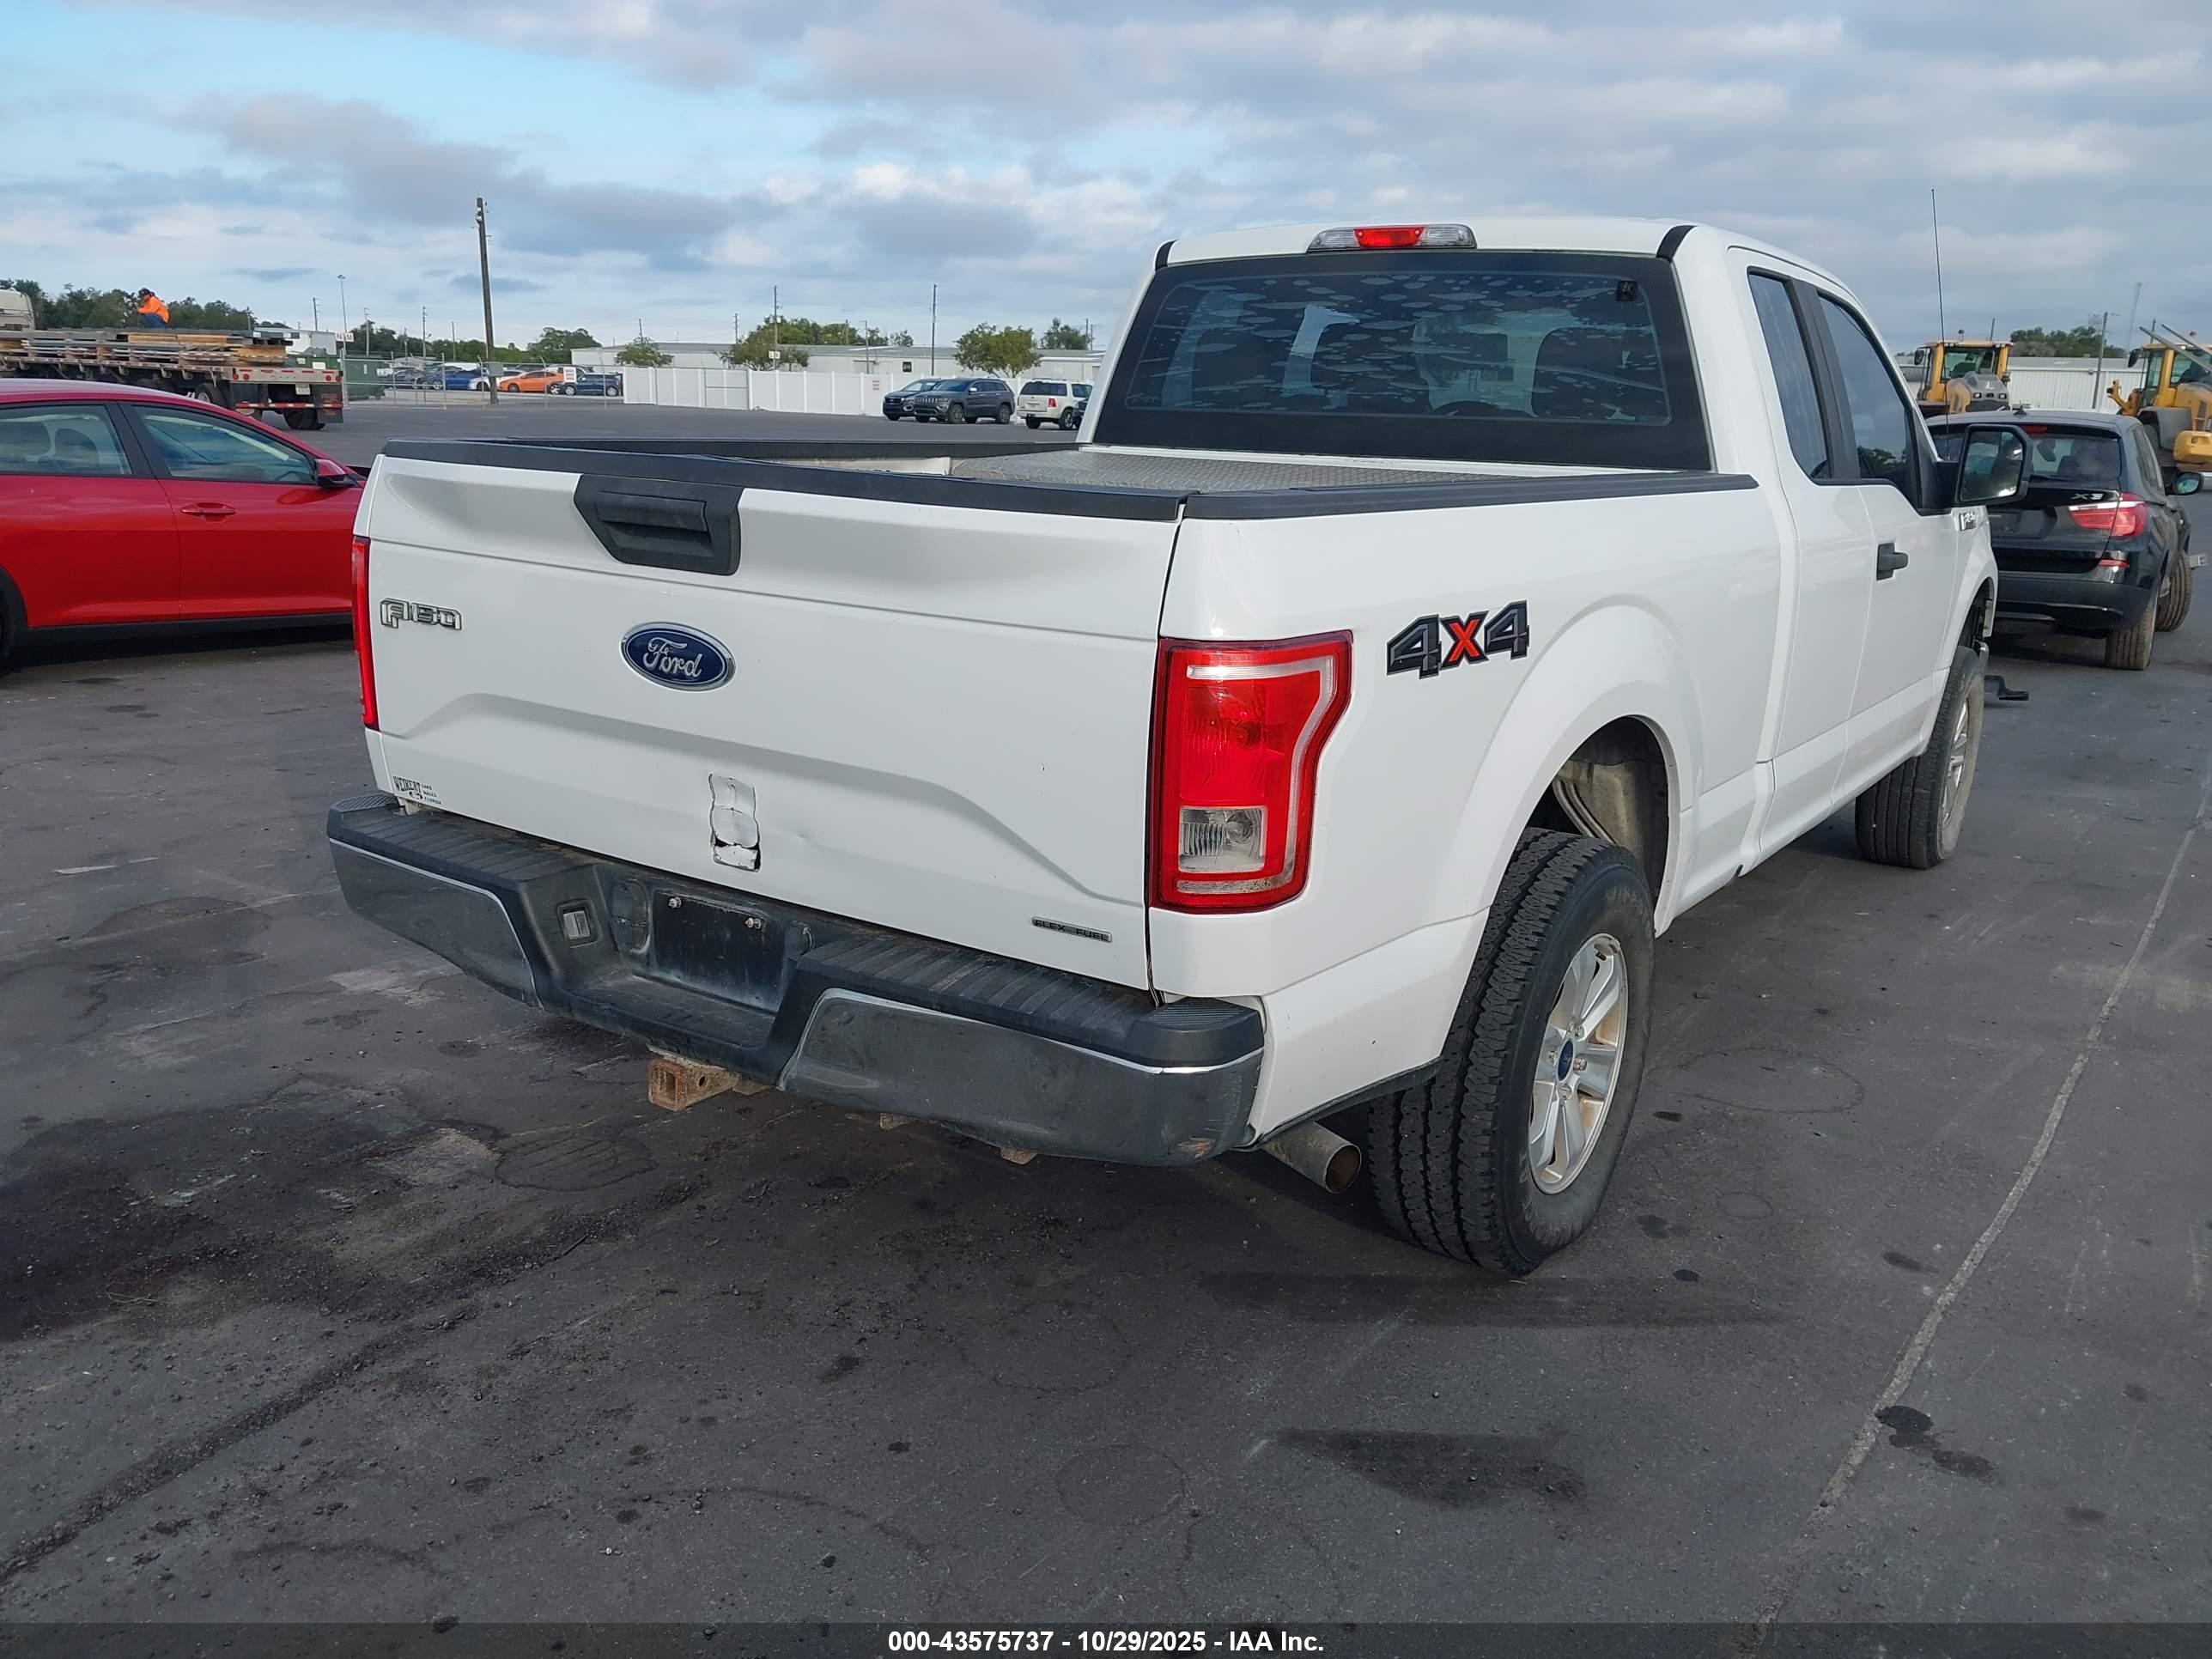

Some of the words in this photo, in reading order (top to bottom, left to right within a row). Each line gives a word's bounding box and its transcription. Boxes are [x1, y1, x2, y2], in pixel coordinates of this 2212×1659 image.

[643, 637, 702, 678] Ford
[1034, 919, 1066, 932] FLEX
[1076, 928, 1109, 942] FUEL
